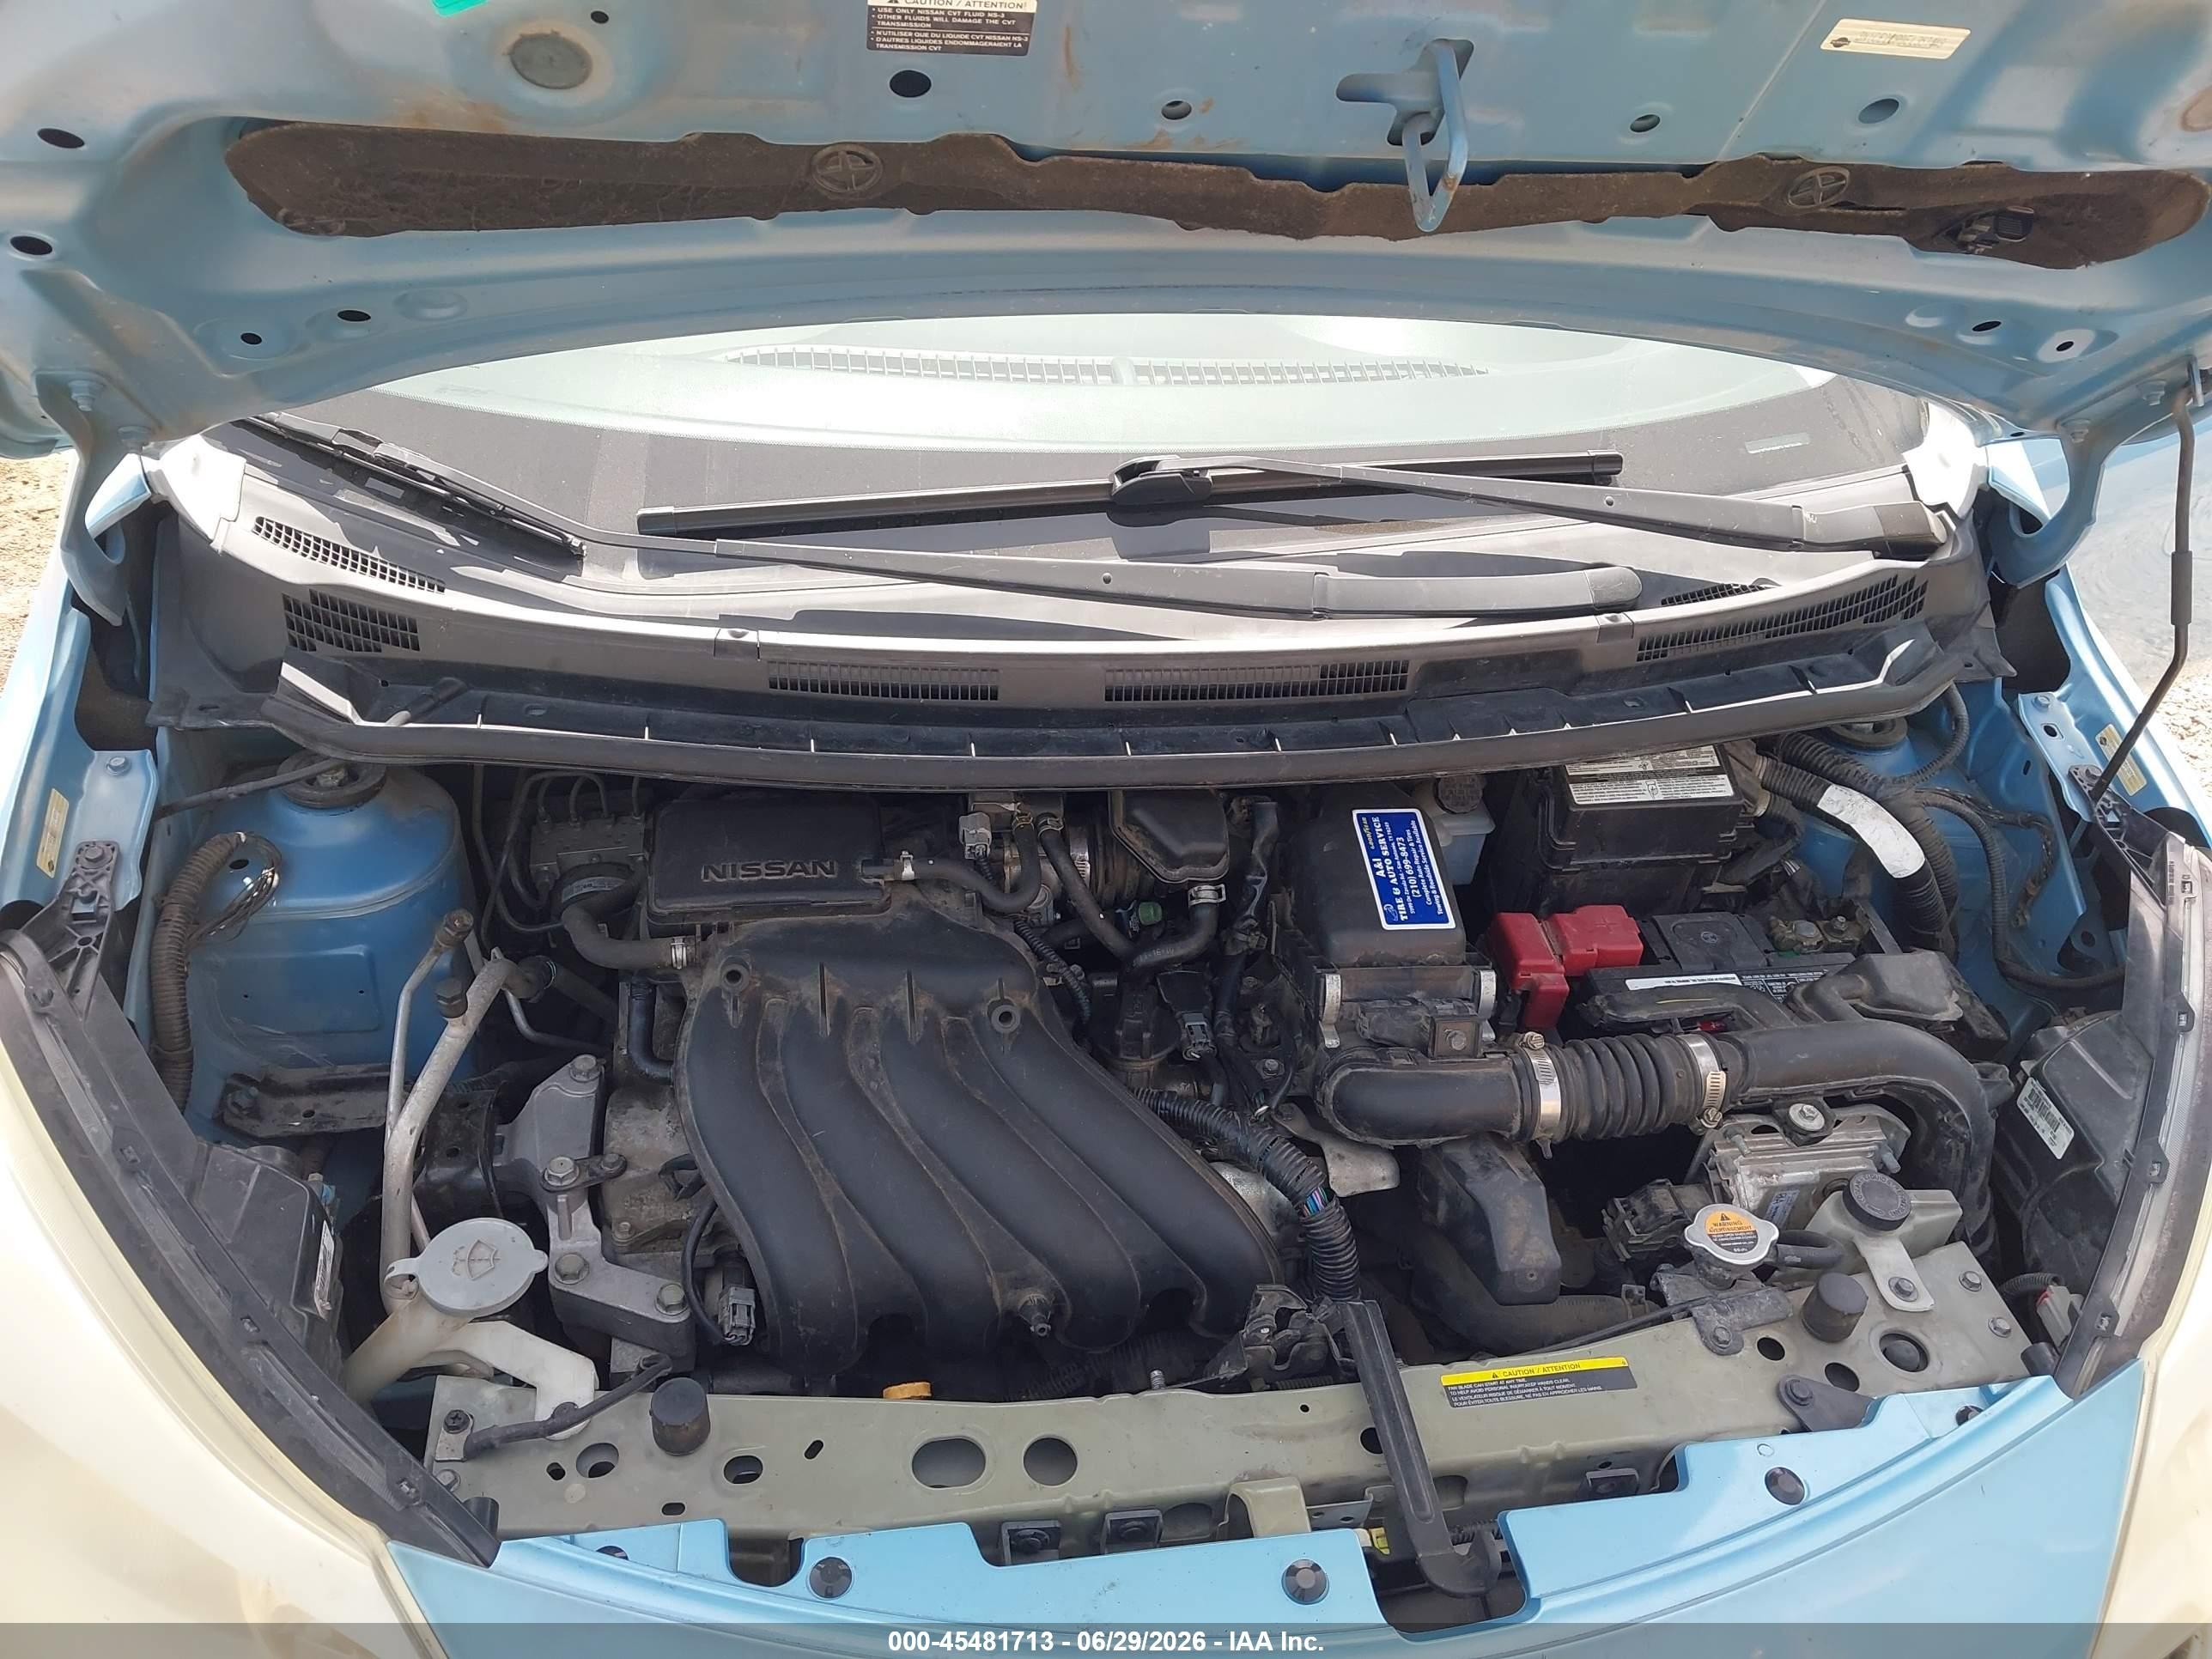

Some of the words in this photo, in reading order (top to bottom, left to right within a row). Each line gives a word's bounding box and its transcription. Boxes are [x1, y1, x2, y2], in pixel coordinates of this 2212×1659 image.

[1371, 817, 1389, 856] SERVICE
[1410, 820, 1422, 844] Available
[1396, 836, 1413, 875] 699-8473
[1411, 848, 1420, 865] Repair
[1419, 844, 1428, 864] Service
[702, 860, 836, 882] NISSAN
[1372, 858, 1386, 878] A&I
[1384, 859, 1398, 884] AUTO
[1424, 864, 1436, 889] Roadside
[1407, 876, 1422, 897] (210)
[1420, 878, 1432, 905] Complete
[1395, 897, 1408, 921] TIRE
[1433, 895, 1443, 915] Towing
[1503, 1369, 1534, 1377] CAUTION
[1543, 1363, 1580, 1373] ATTENTION
